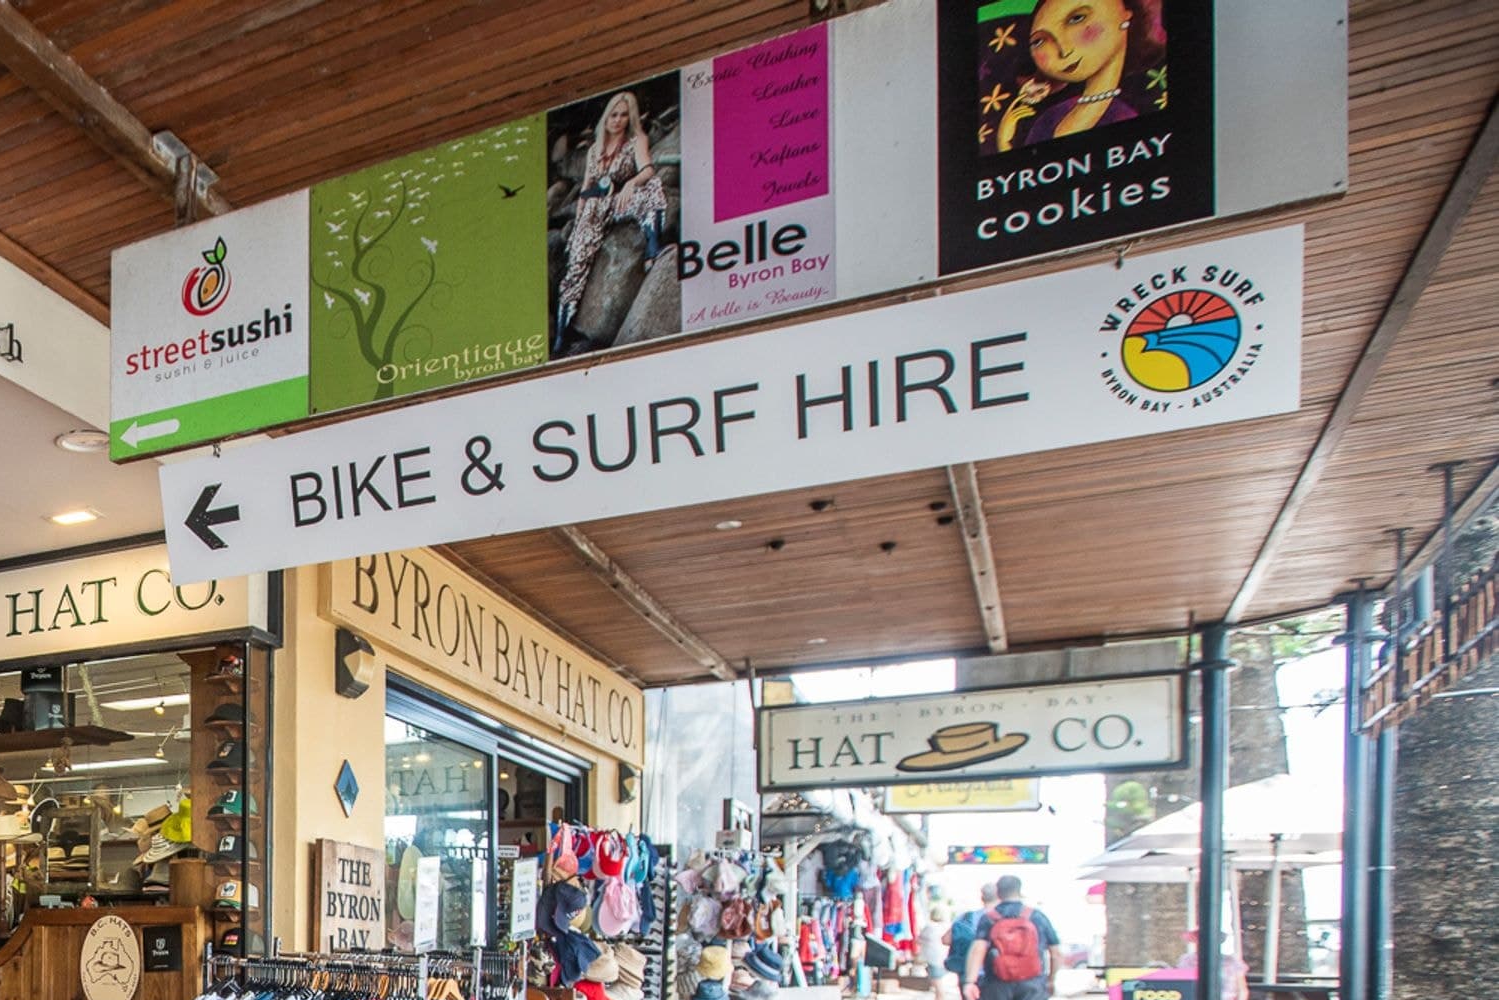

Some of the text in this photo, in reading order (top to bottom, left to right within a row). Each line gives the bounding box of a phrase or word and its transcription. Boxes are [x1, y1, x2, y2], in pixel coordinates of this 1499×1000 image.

[747, 40, 819, 71] Clothing
[977, 133, 1174, 201] BYRON BAY
[977, 171, 1172, 241] cookies
[677, 220, 807, 281] Belle
[729, 254, 830, 289] Byron Bay
[710, 298, 741, 320] belle
[1099, 264, 1266, 332] WRECK SURF
[155, 363, 197, 382] sushi
[219, 348, 260, 369] juice
[376, 334, 545, 384] Orientique
[455, 352, 545, 381] byron bay
[1101, 368, 1138, 406] BYRON
[1140, 399, 1172, 413] BAY
[1192, 343, 1263, 408] AUSTRALIA
[290, 332, 1030, 528] BIKE & SURF HIRE
[6, 578, 119, 636] HAT
[353, 555, 637, 750] BYRON BAY HAT CO.
[834, 694, 1097, 726] THE BYRON BAY
[787, 714, 1144, 770] HAT CO.
[338, 858, 371, 887] THE
[326, 891, 381, 921] BYRON
[338, 927, 371, 949] BAY
